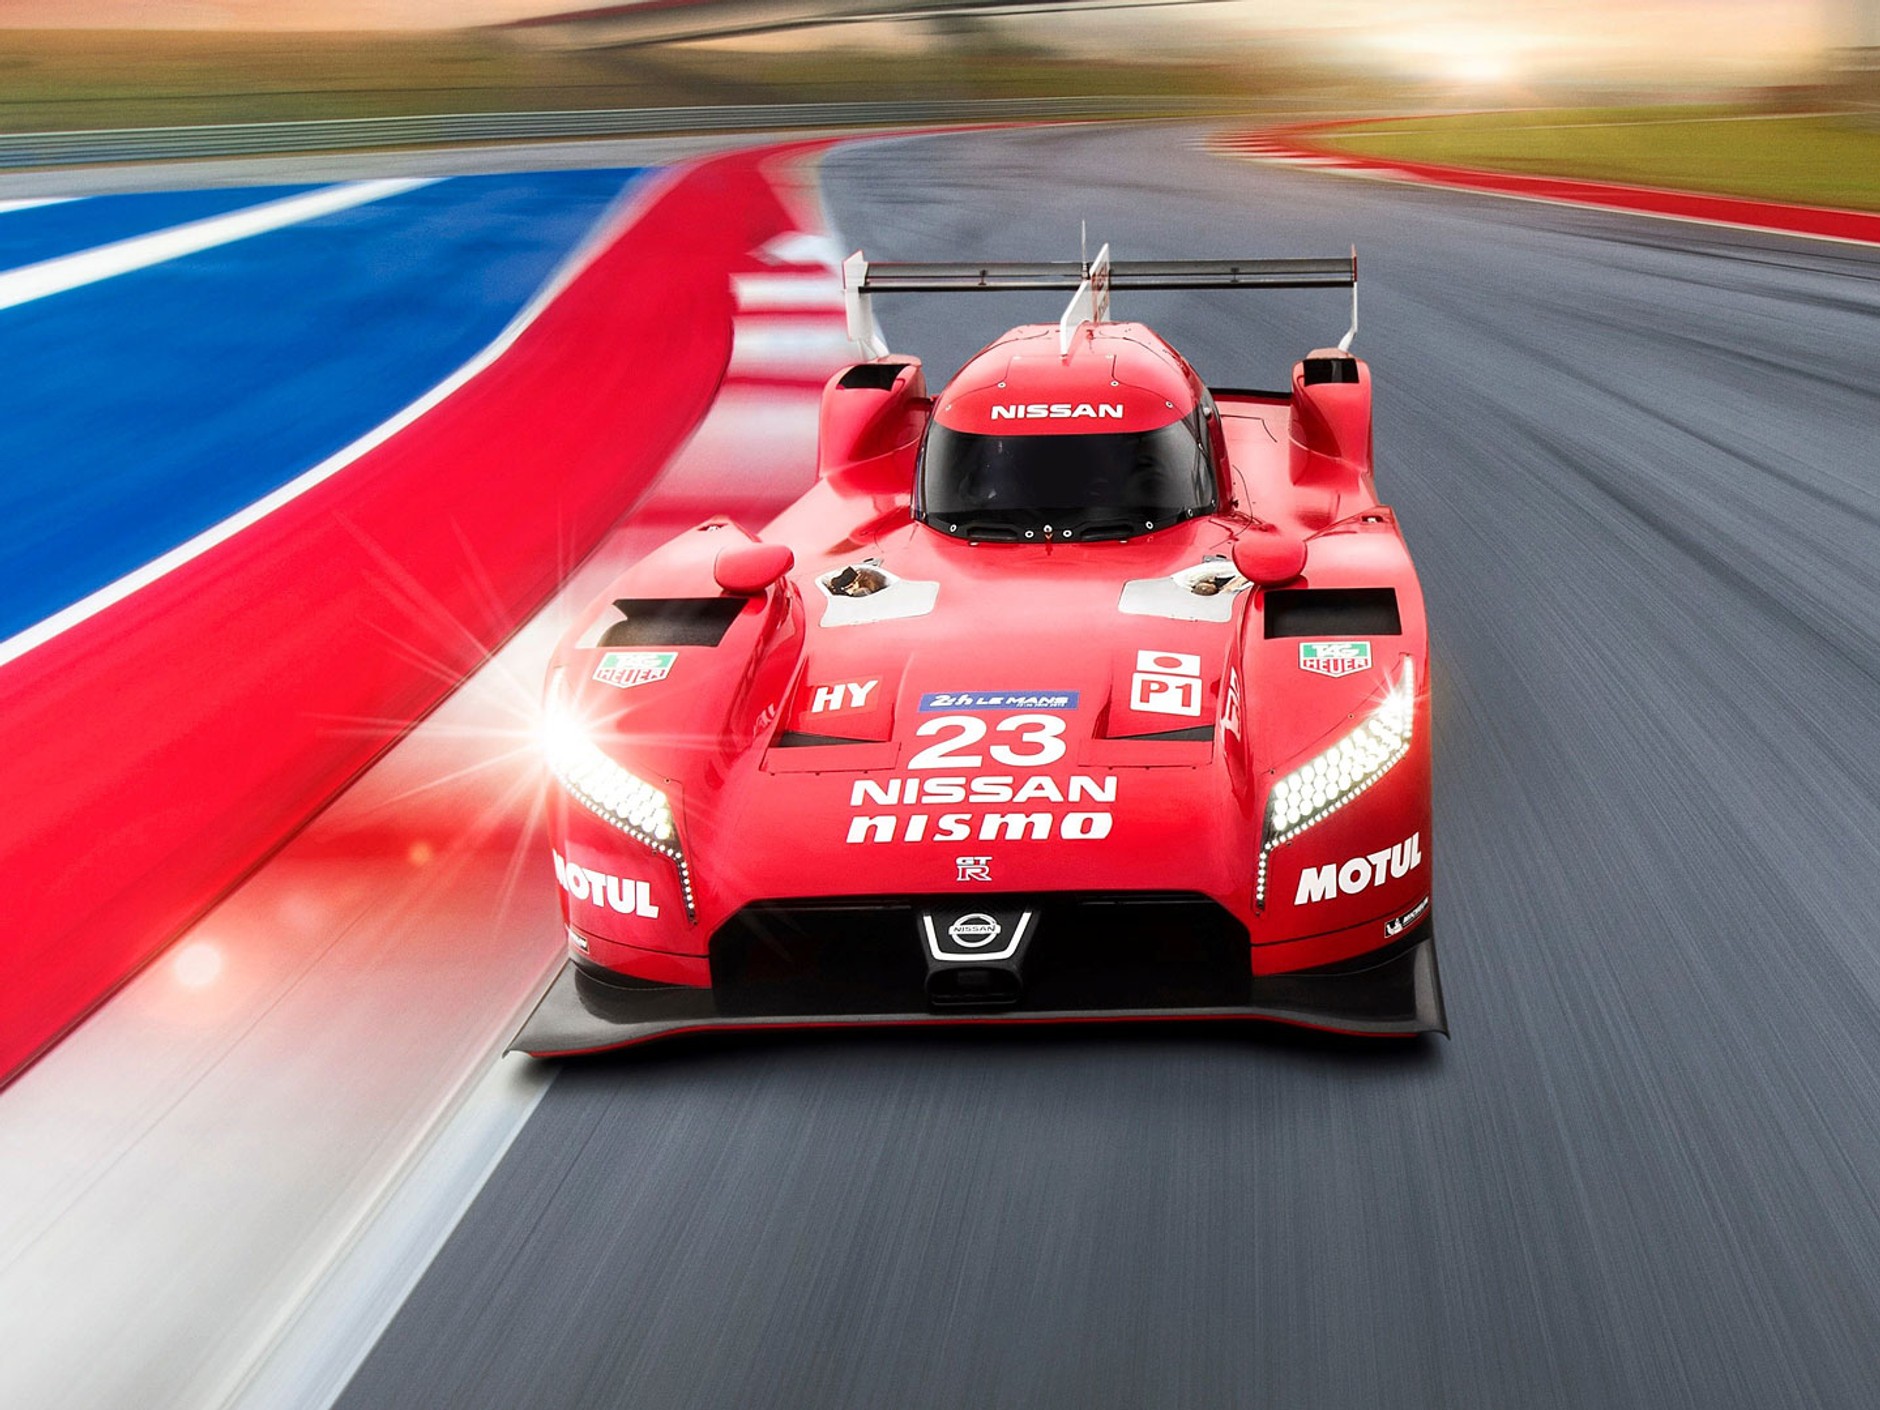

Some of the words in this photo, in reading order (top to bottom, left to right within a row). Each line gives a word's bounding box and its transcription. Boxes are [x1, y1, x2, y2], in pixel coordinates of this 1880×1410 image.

[991, 403, 1123, 420] NISSAN
[596, 668, 667, 686] HEUER
[1303, 658, 1368, 674] HEUER
[811, 680, 879, 713] HY
[976, 696, 1004, 705] LE
[1005, 696, 1069, 705] MANS
[1139, 679, 1193, 707] P1
[907, 714, 1067, 770] 23
[850, 776, 1117, 806] NISSAN
[846, 812, 1113, 843] nismo
[955, 856, 993, 866] GT
[956, 865, 992, 881] R
[1294, 831, 1422, 906] MOTUL
[552, 847, 660, 919] MOTUL
